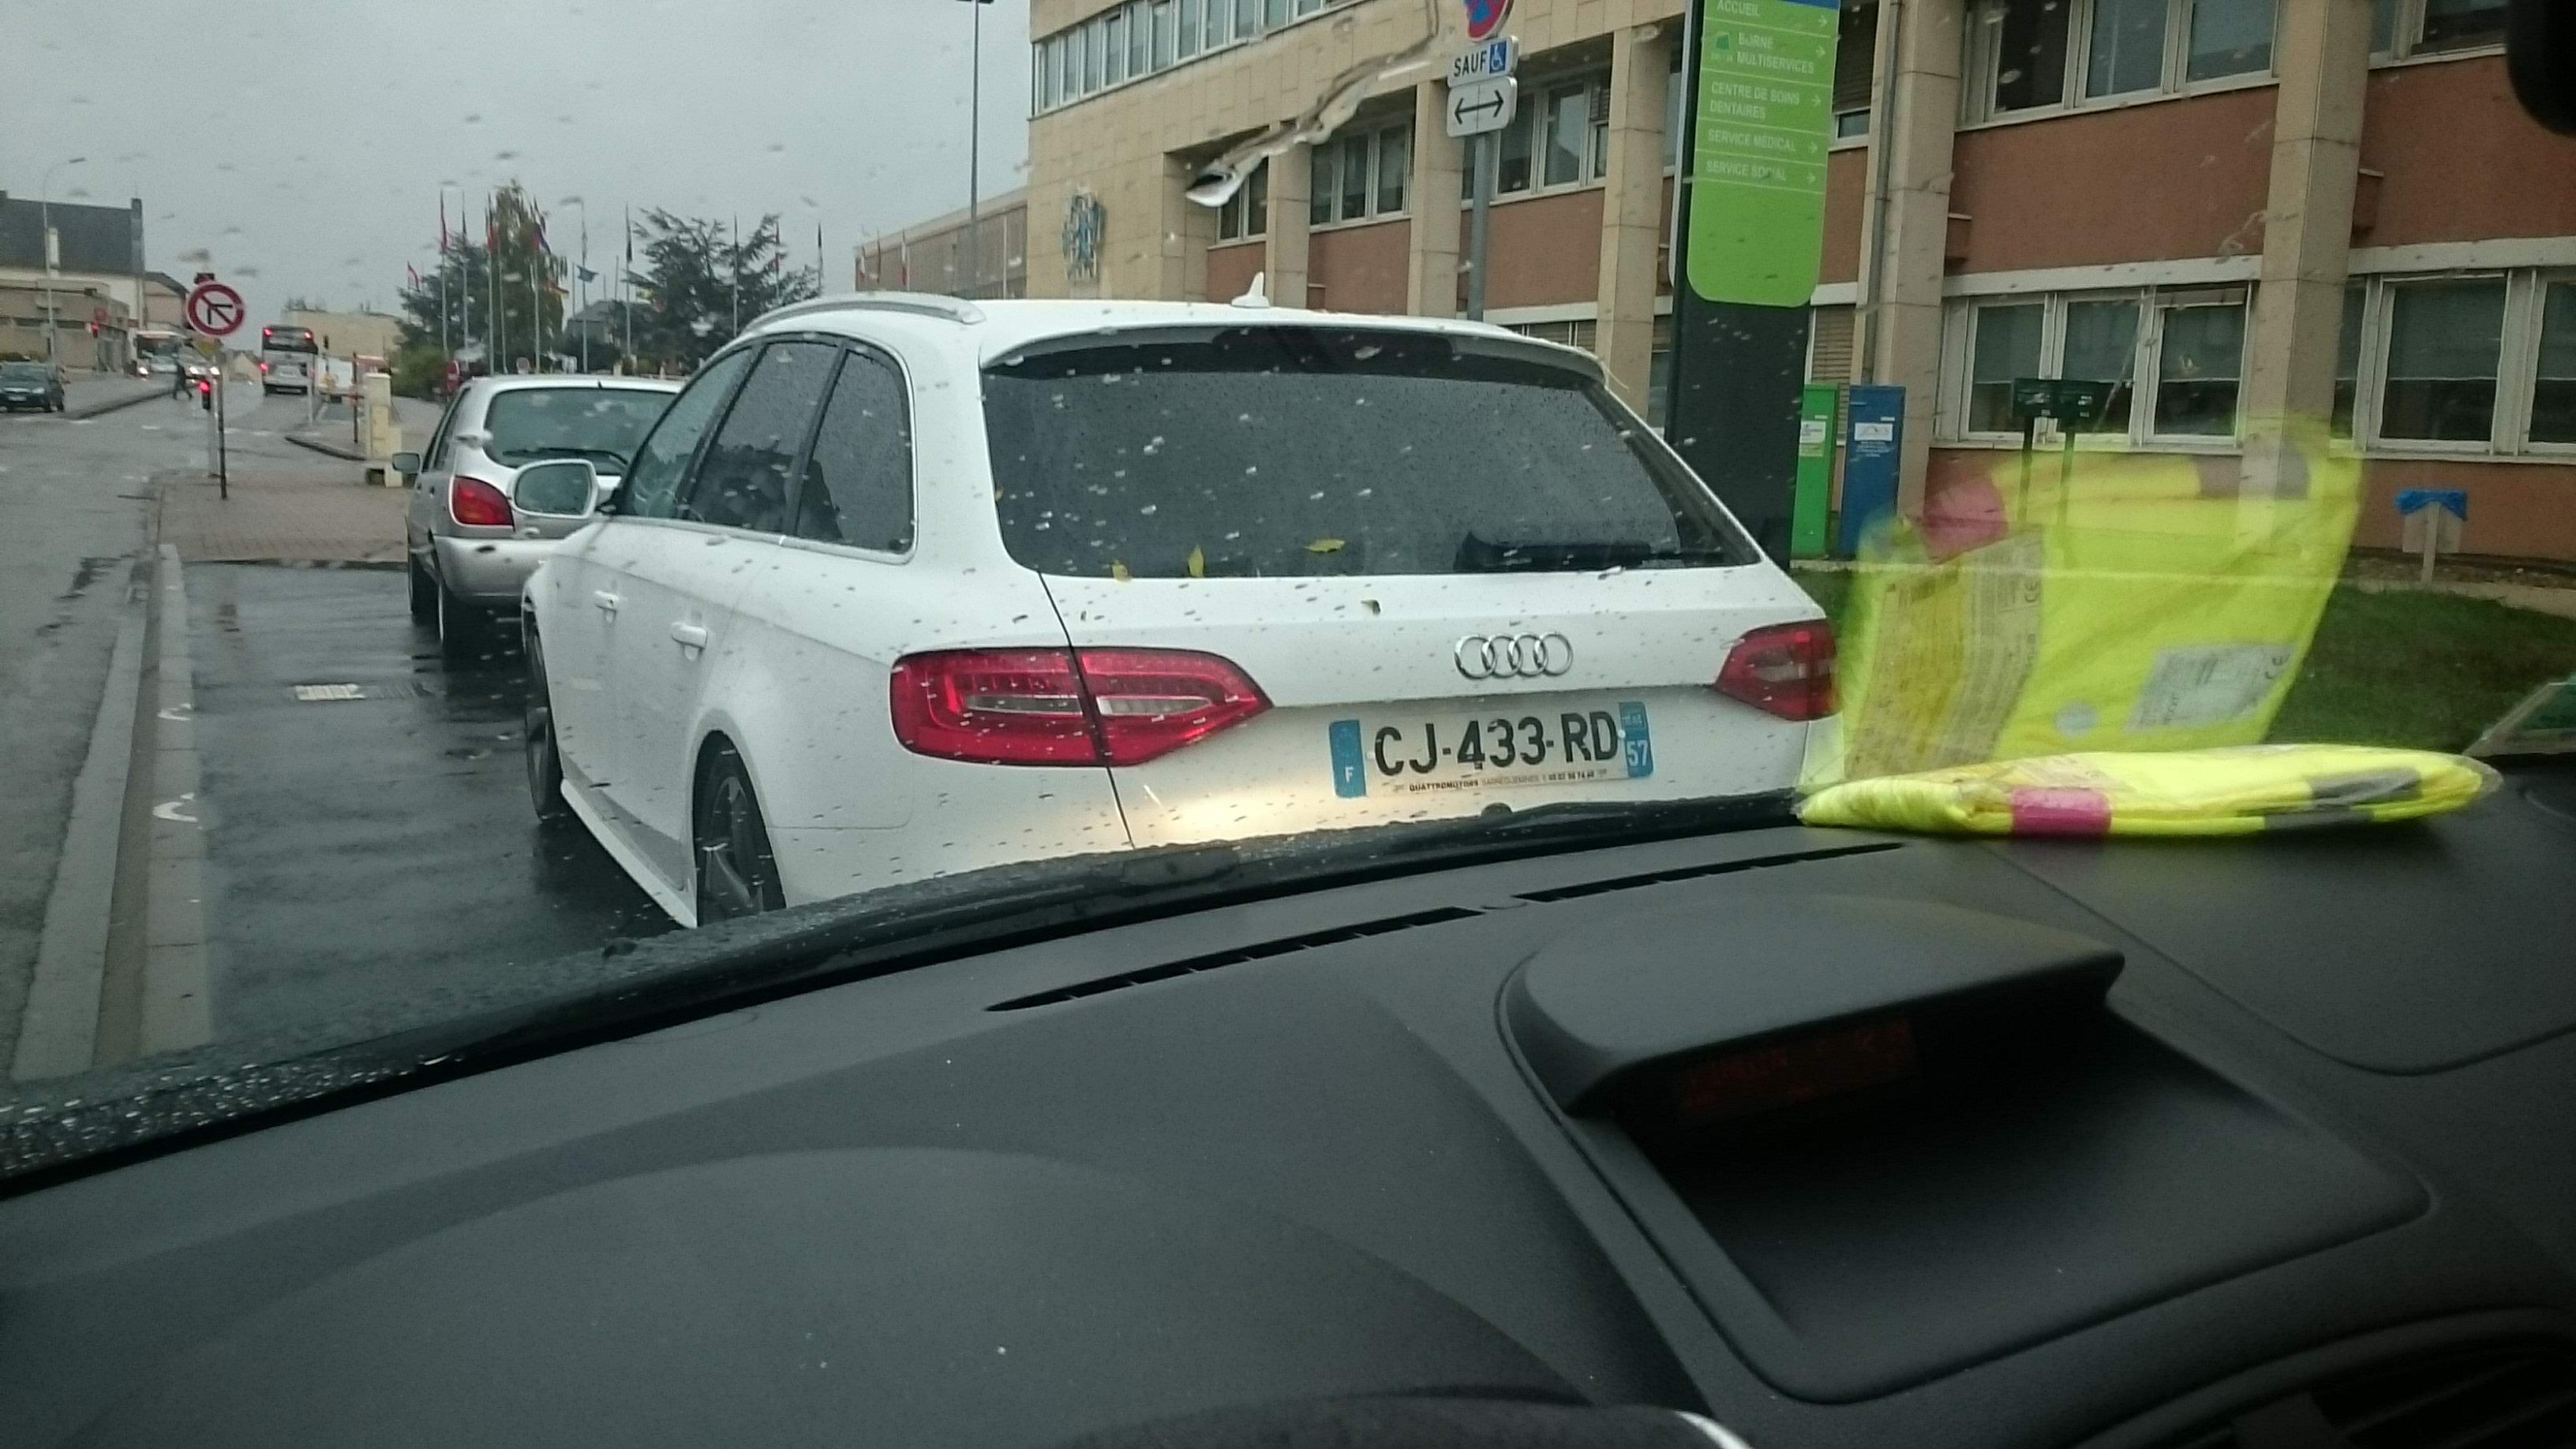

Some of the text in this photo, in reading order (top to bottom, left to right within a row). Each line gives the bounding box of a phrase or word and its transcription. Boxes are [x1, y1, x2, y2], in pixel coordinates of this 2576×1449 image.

[1717, 0, 1761, 17] ACCUEIL
[1739, 32, 1774, 50] BORNE
[1454, 51, 1488, 77] SAUF
[1737, 51, 1814, 75] MULTISERVICES
[1711, 81, 1800, 106] CENTRE DE SOINS
[1710, 99, 1766, 120] DENTAIRES
[1708, 129, 1751, 147] SERVICE
[1705, 160, 1750, 177] SERVICE
[1375, 711, 1619, 776] CJ-433-RD
[1627, 739, 1648, 768] 57
[1345, 766, 1354, 782] F
